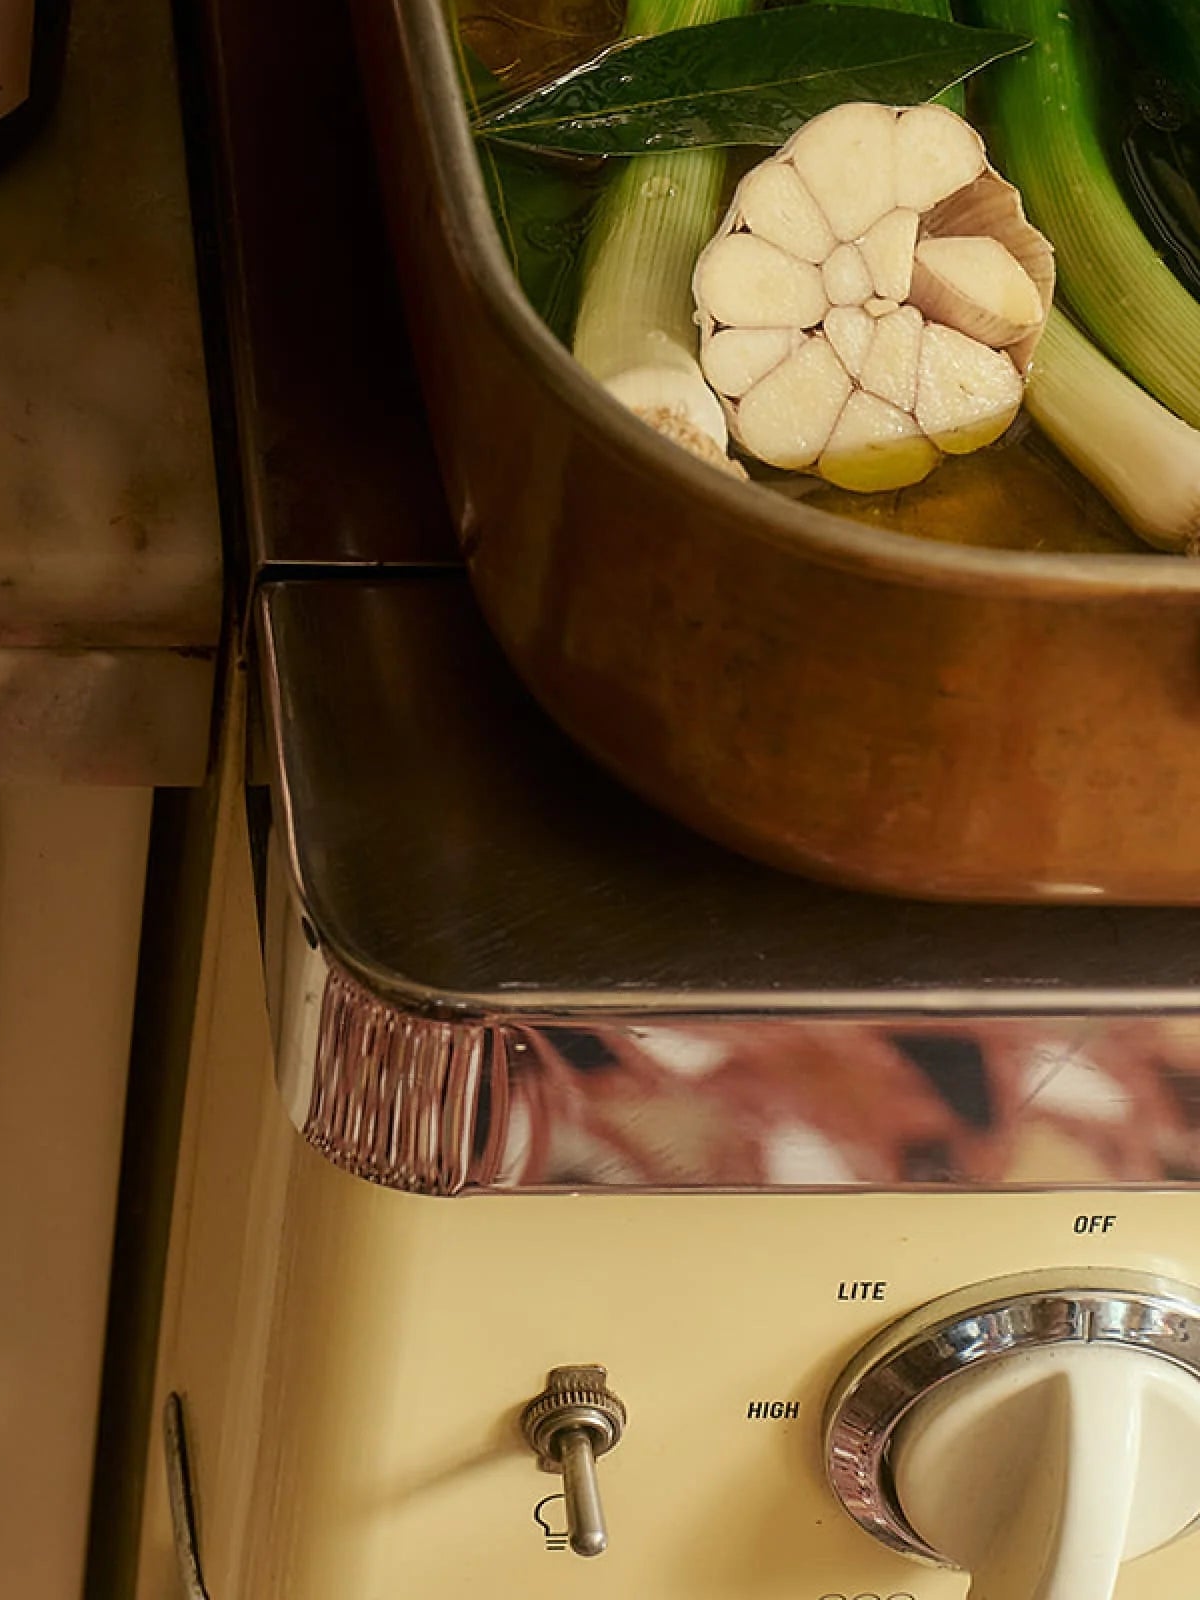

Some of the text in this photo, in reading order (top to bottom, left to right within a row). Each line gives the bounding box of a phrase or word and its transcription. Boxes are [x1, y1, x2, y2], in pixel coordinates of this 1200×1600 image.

[1073, 1216, 1117, 1234] OFF
[837, 1282, 886, 1300] LITE
[747, 1401, 800, 1420] HIGH
